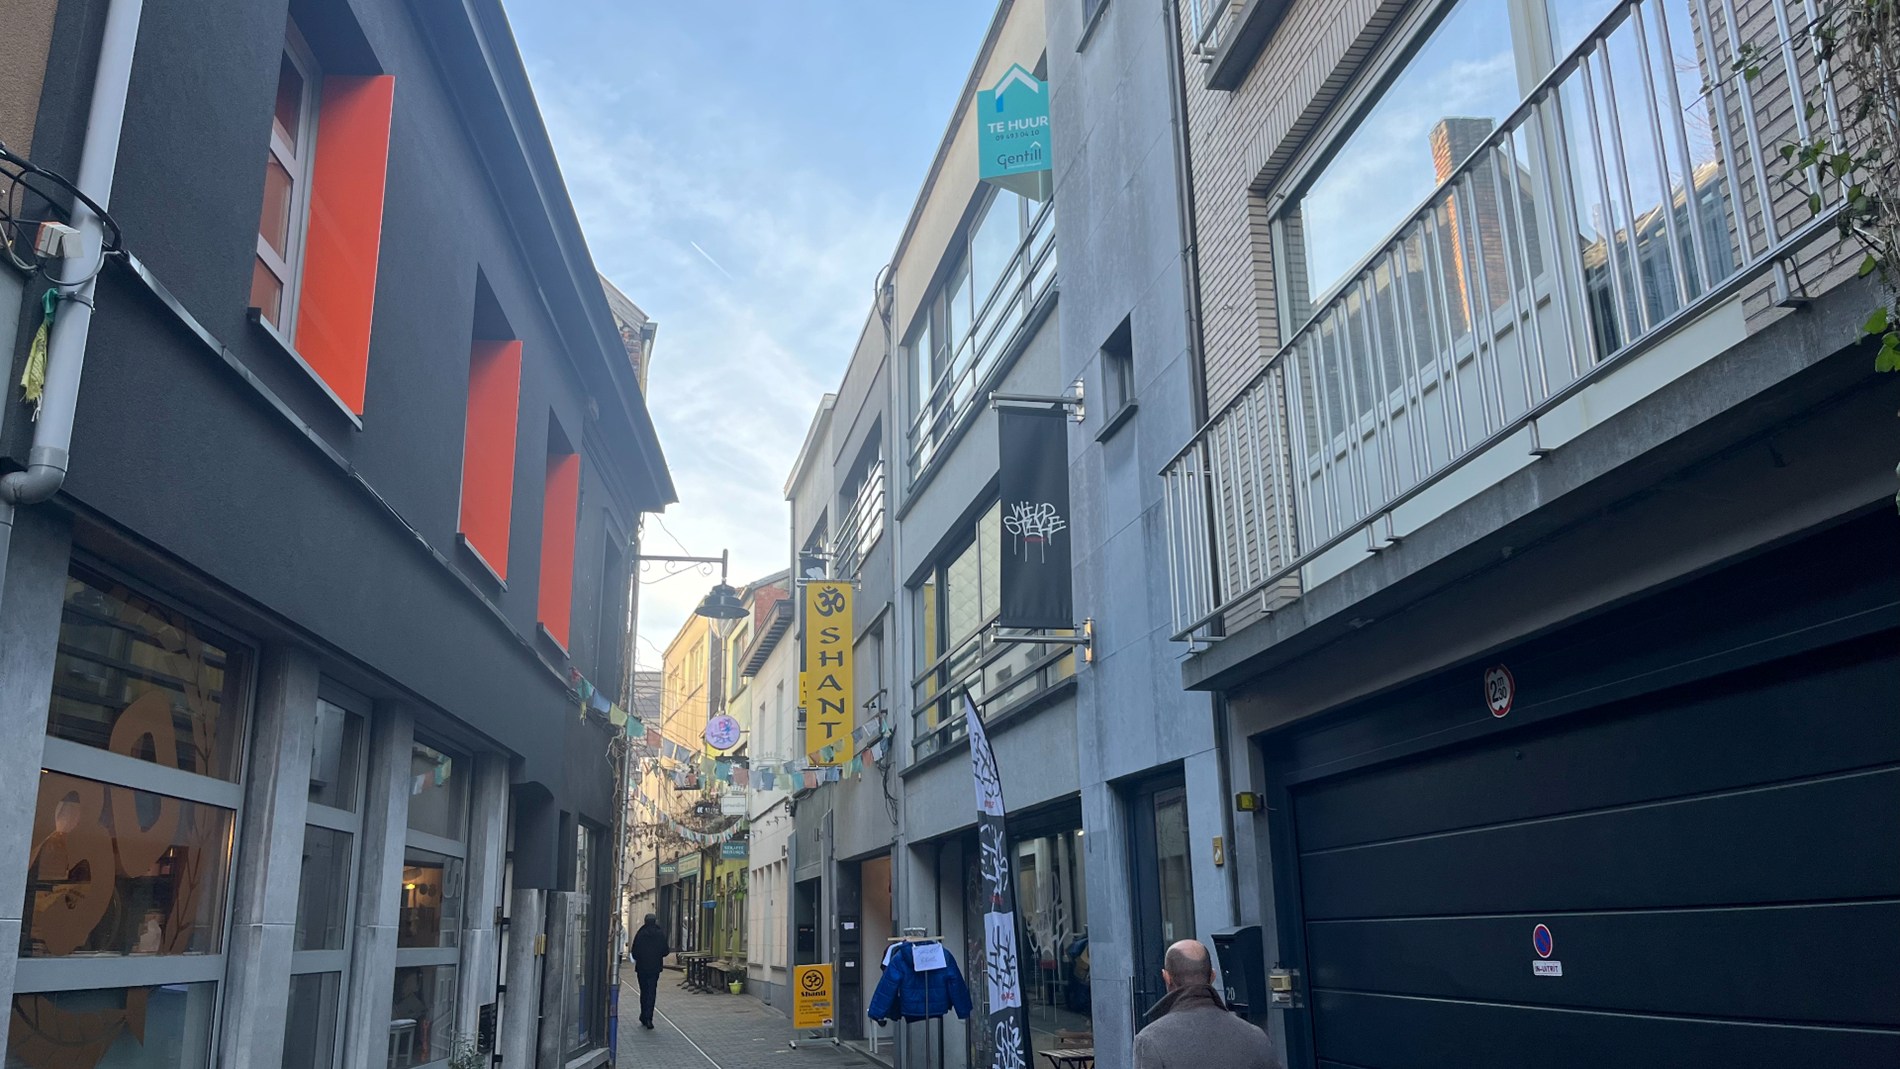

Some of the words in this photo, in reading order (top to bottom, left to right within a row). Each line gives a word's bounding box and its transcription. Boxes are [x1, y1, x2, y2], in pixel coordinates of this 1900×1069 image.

[988, 122, 1005, 133] TE
[1008, 116, 1048, 130] HUUR
[1031, 129, 1040, 137] 10
[1225, 986, 1236, 1001] 20
